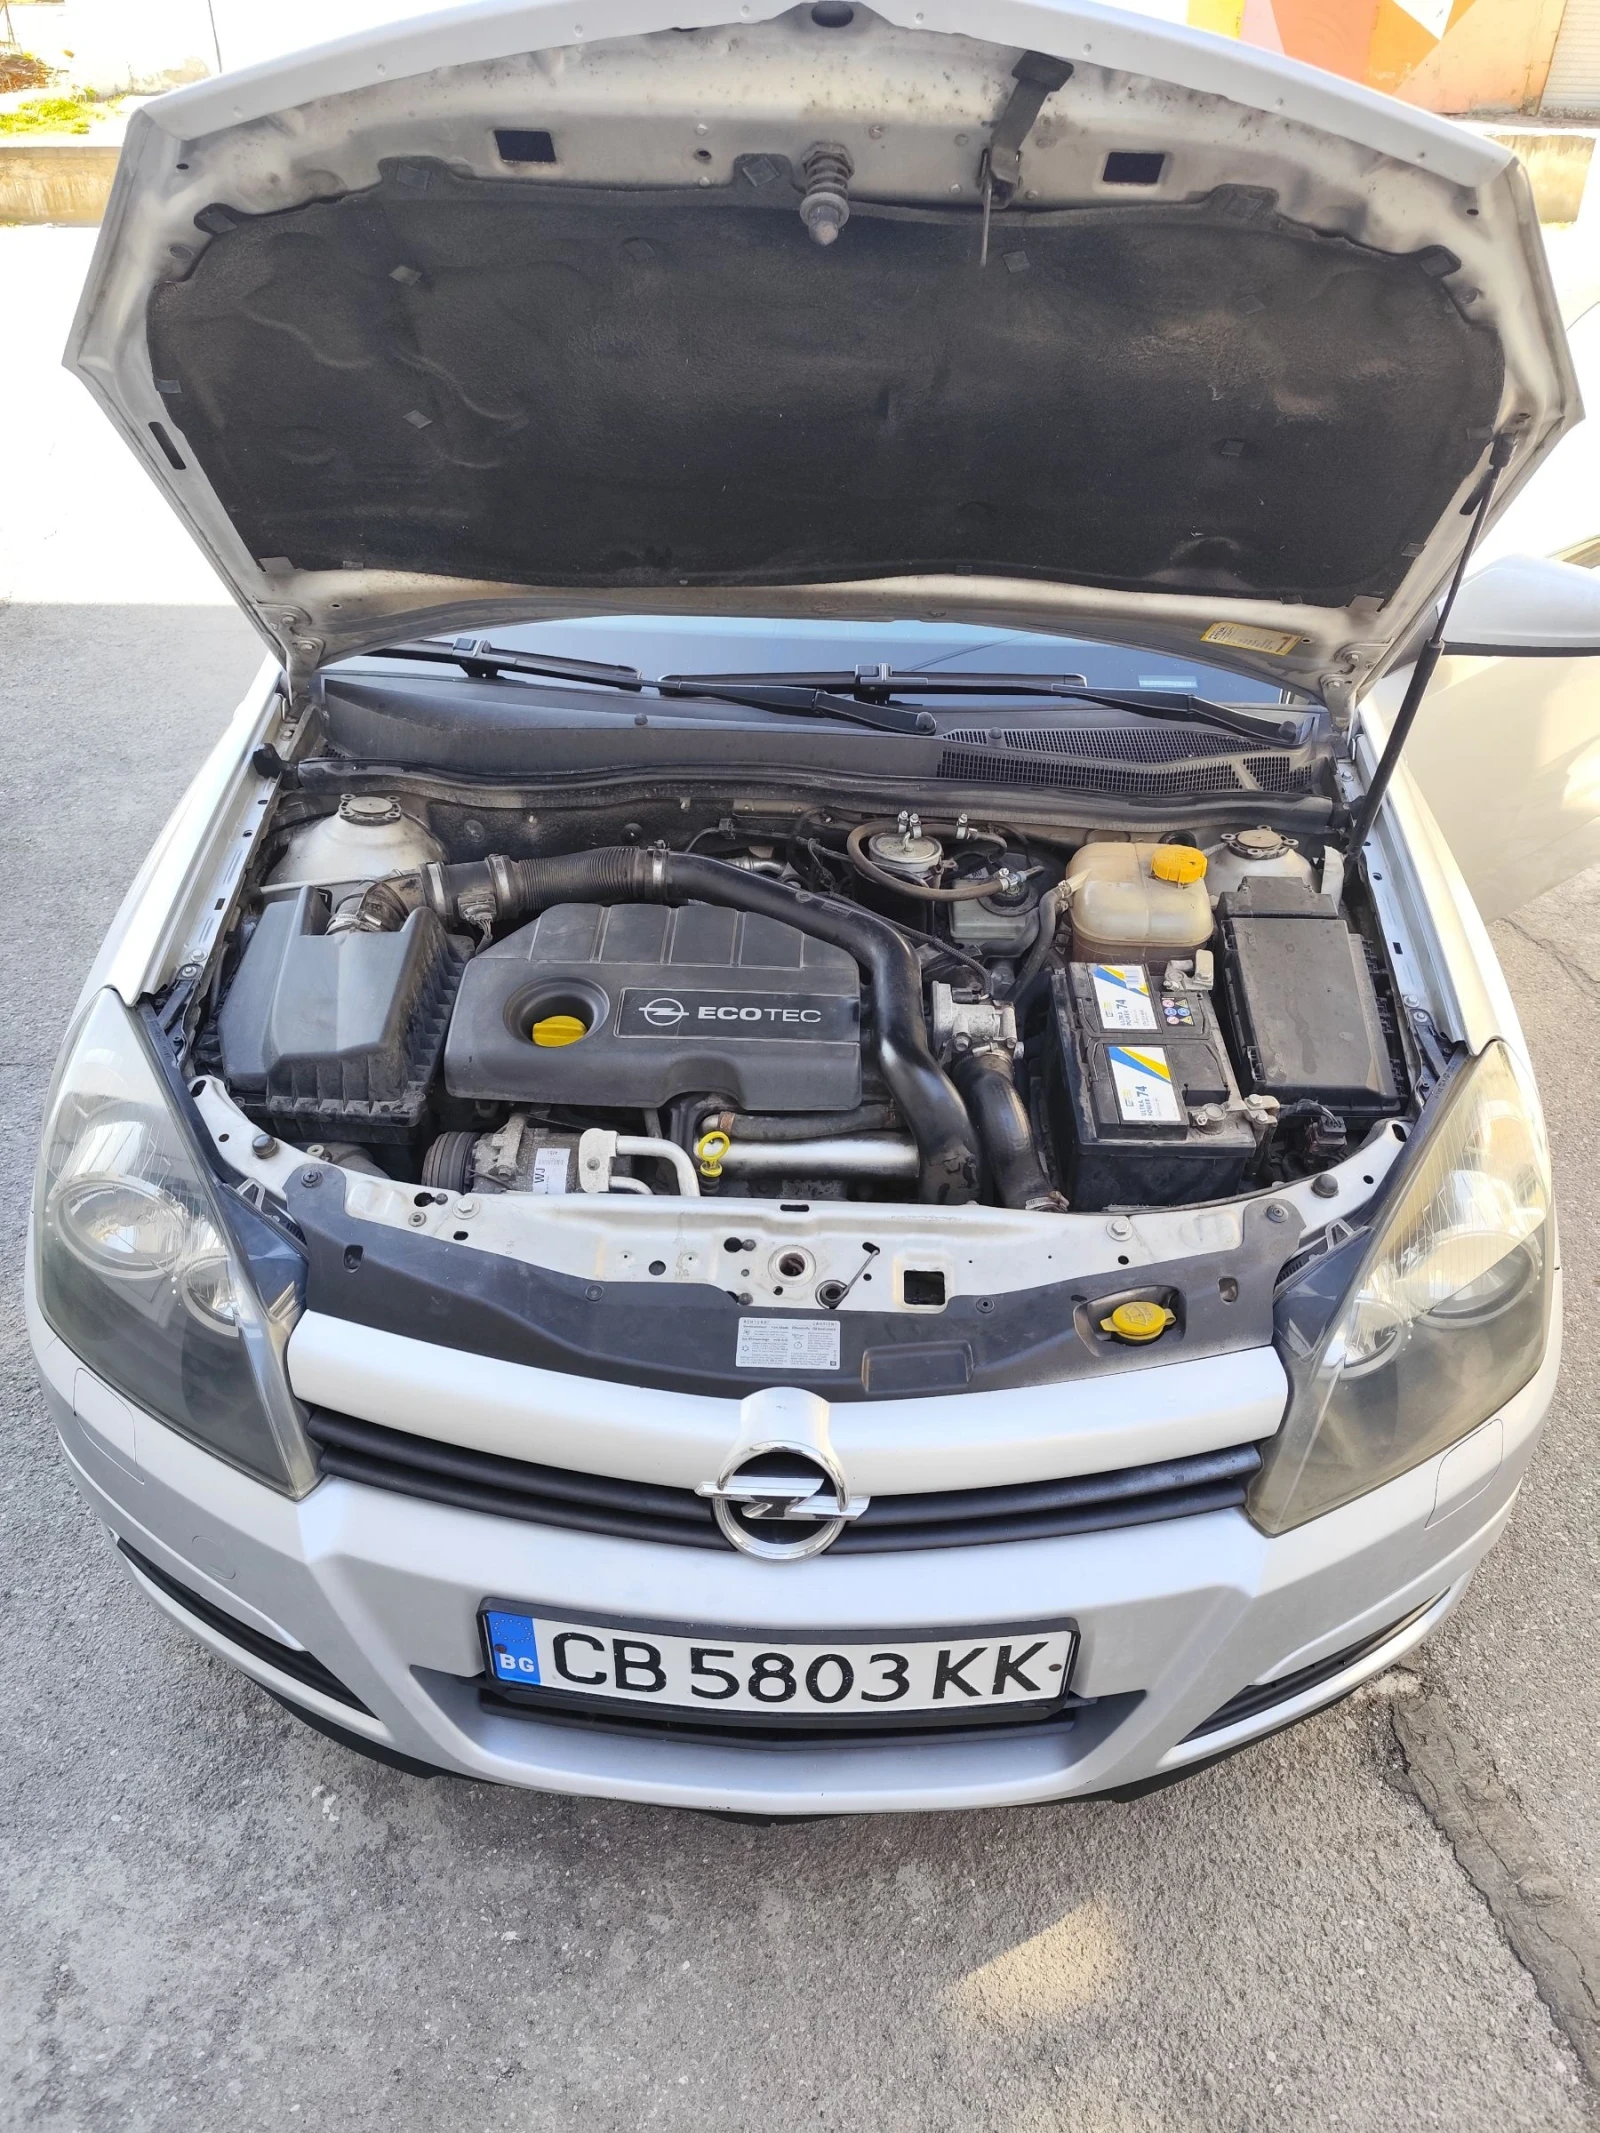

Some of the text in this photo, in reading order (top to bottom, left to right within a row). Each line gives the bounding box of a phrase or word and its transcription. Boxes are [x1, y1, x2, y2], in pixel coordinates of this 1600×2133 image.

[1115, 999, 1128, 1009] 74
[697, 1006, 822, 1023] ECOTEC
[1135, 1085, 1149, 1097] 74
[533, 1167, 546, 1184] WJ
[499, 1653, 536, 1674] BG
[552, 1631, 1049, 1704] CB 5803 KK
